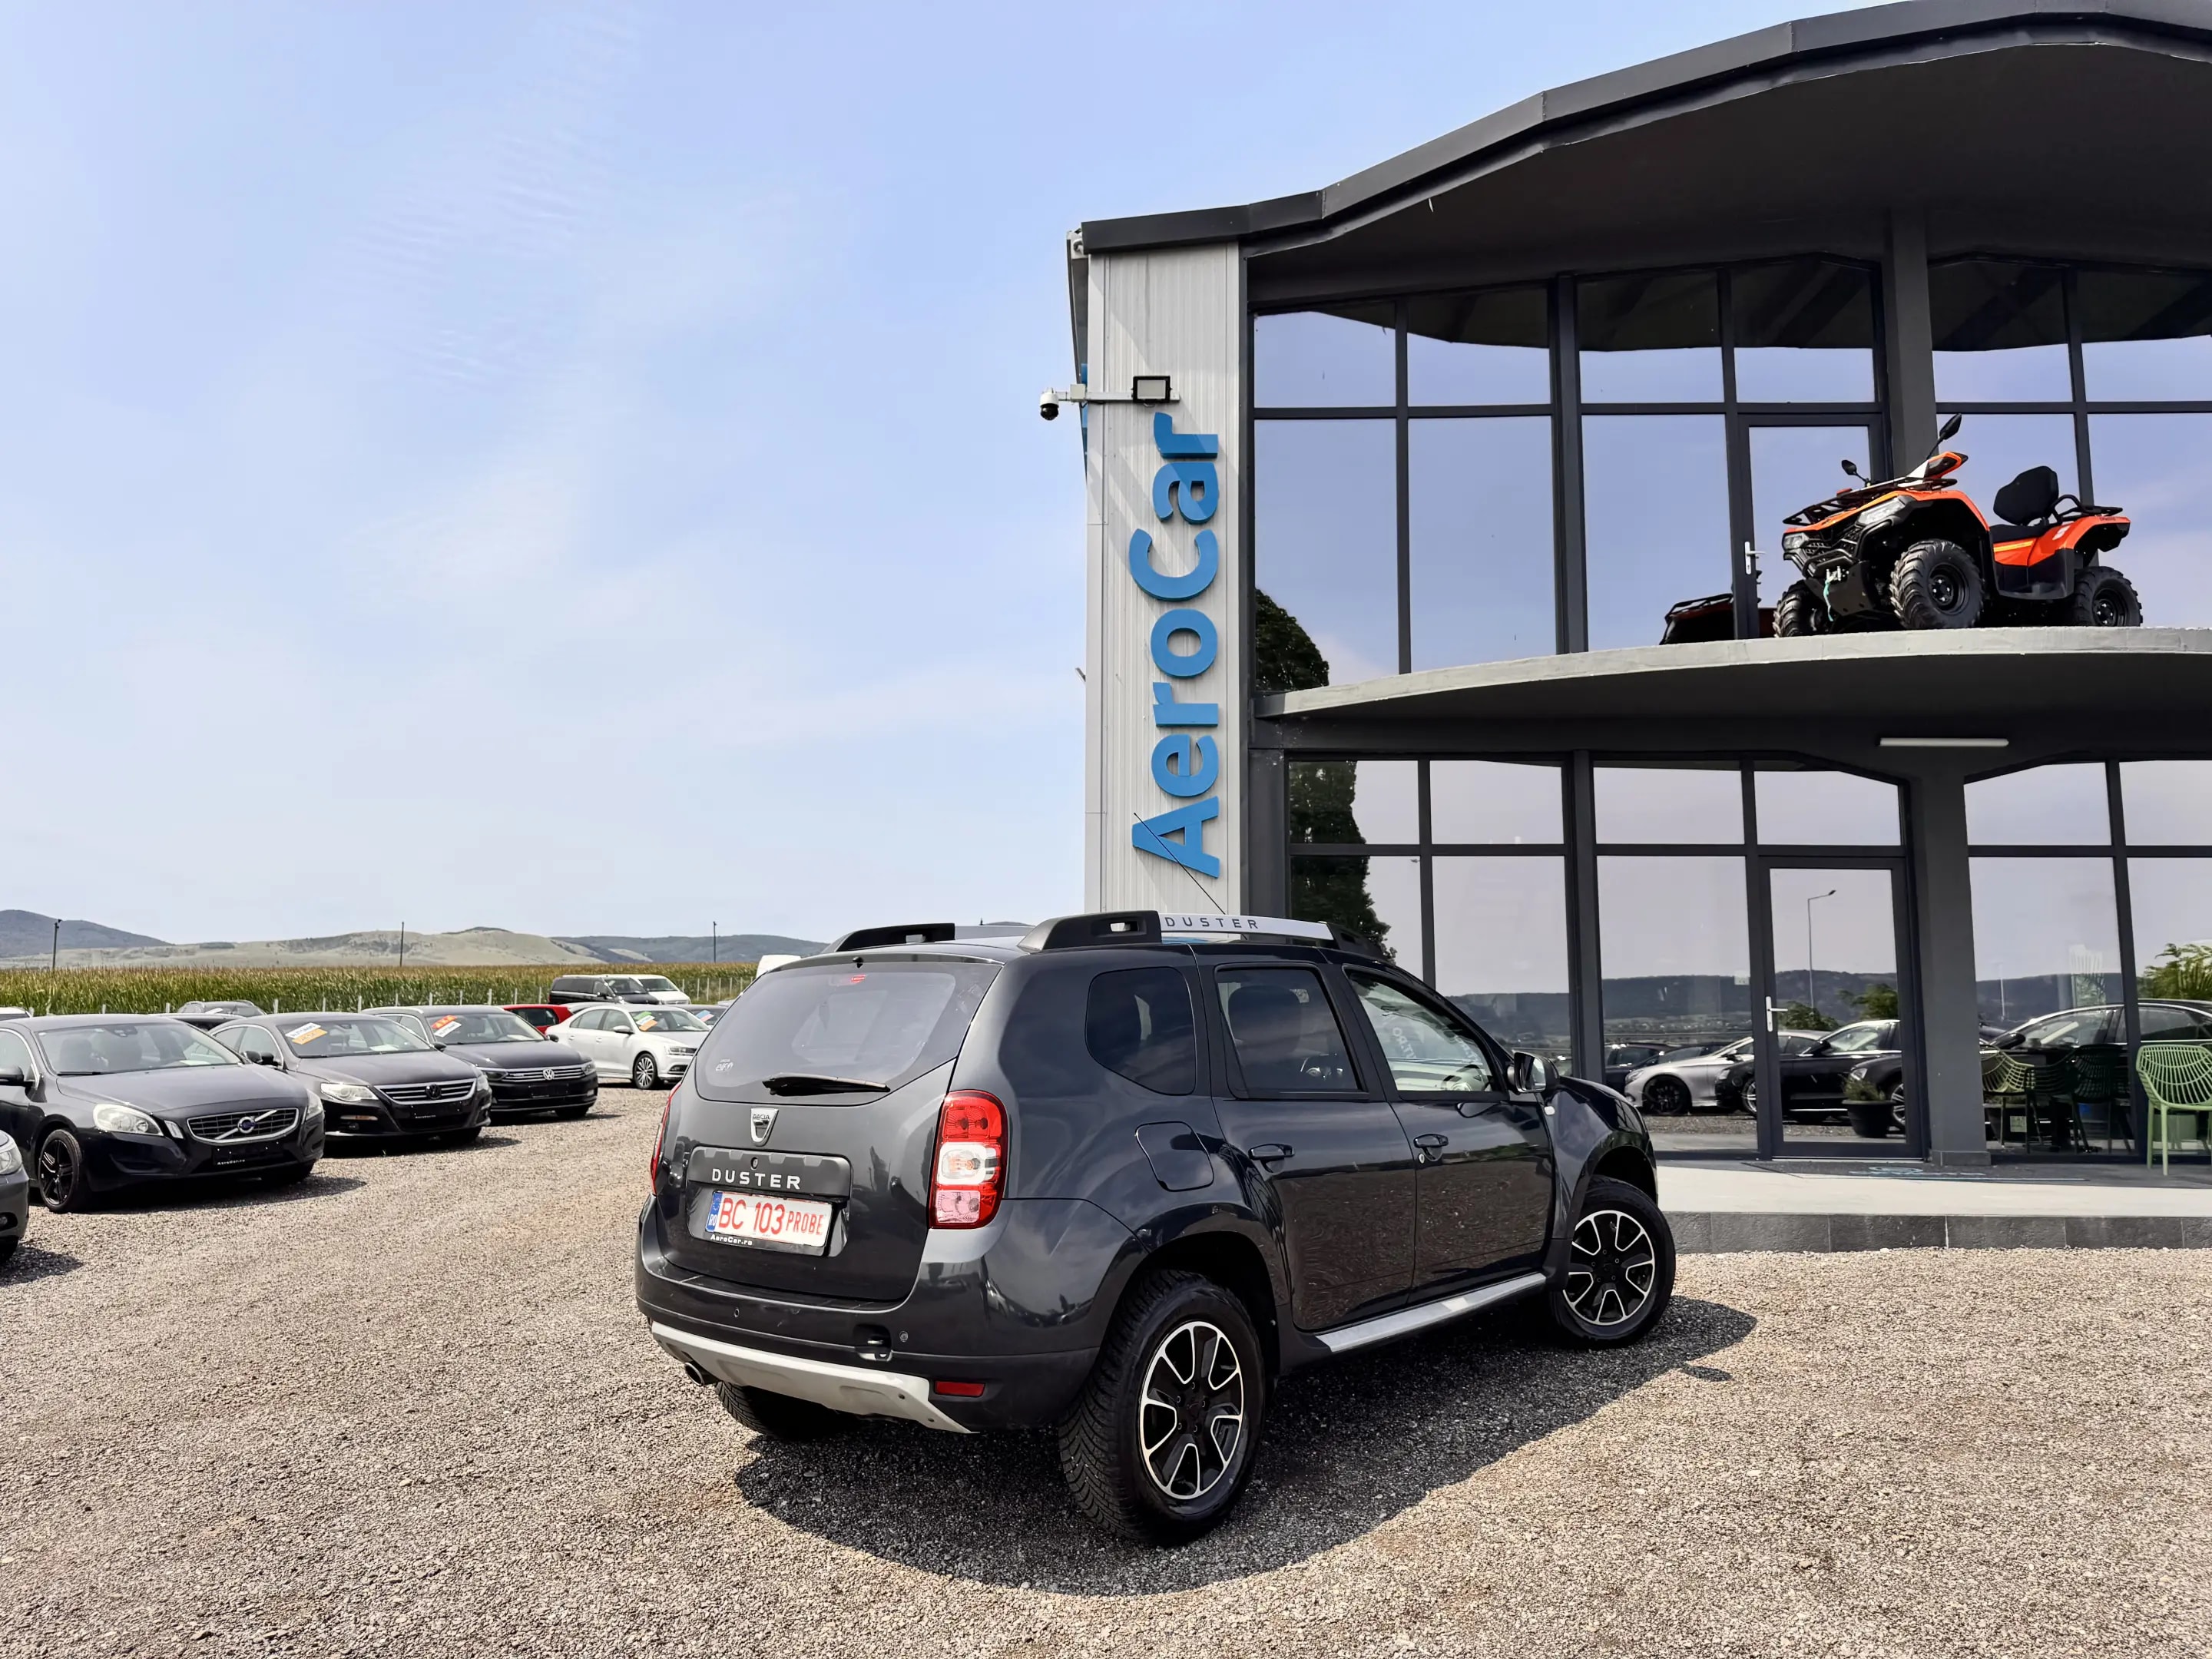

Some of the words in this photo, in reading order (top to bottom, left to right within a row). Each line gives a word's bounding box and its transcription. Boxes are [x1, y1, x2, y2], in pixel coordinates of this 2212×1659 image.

[1129, 412, 1219, 878] AeroCar
[1165, 916, 1258, 929] DUSTER
[712, 1168, 800, 1190] DUSTER
[708, 1214, 717, 1227] RO
[720, 1197, 747, 1230] BC
[753, 1201, 785, 1234] 103
[786, 1210, 824, 1236] PROBE
[710, 1233, 753, 1246] AeroCar.ro
